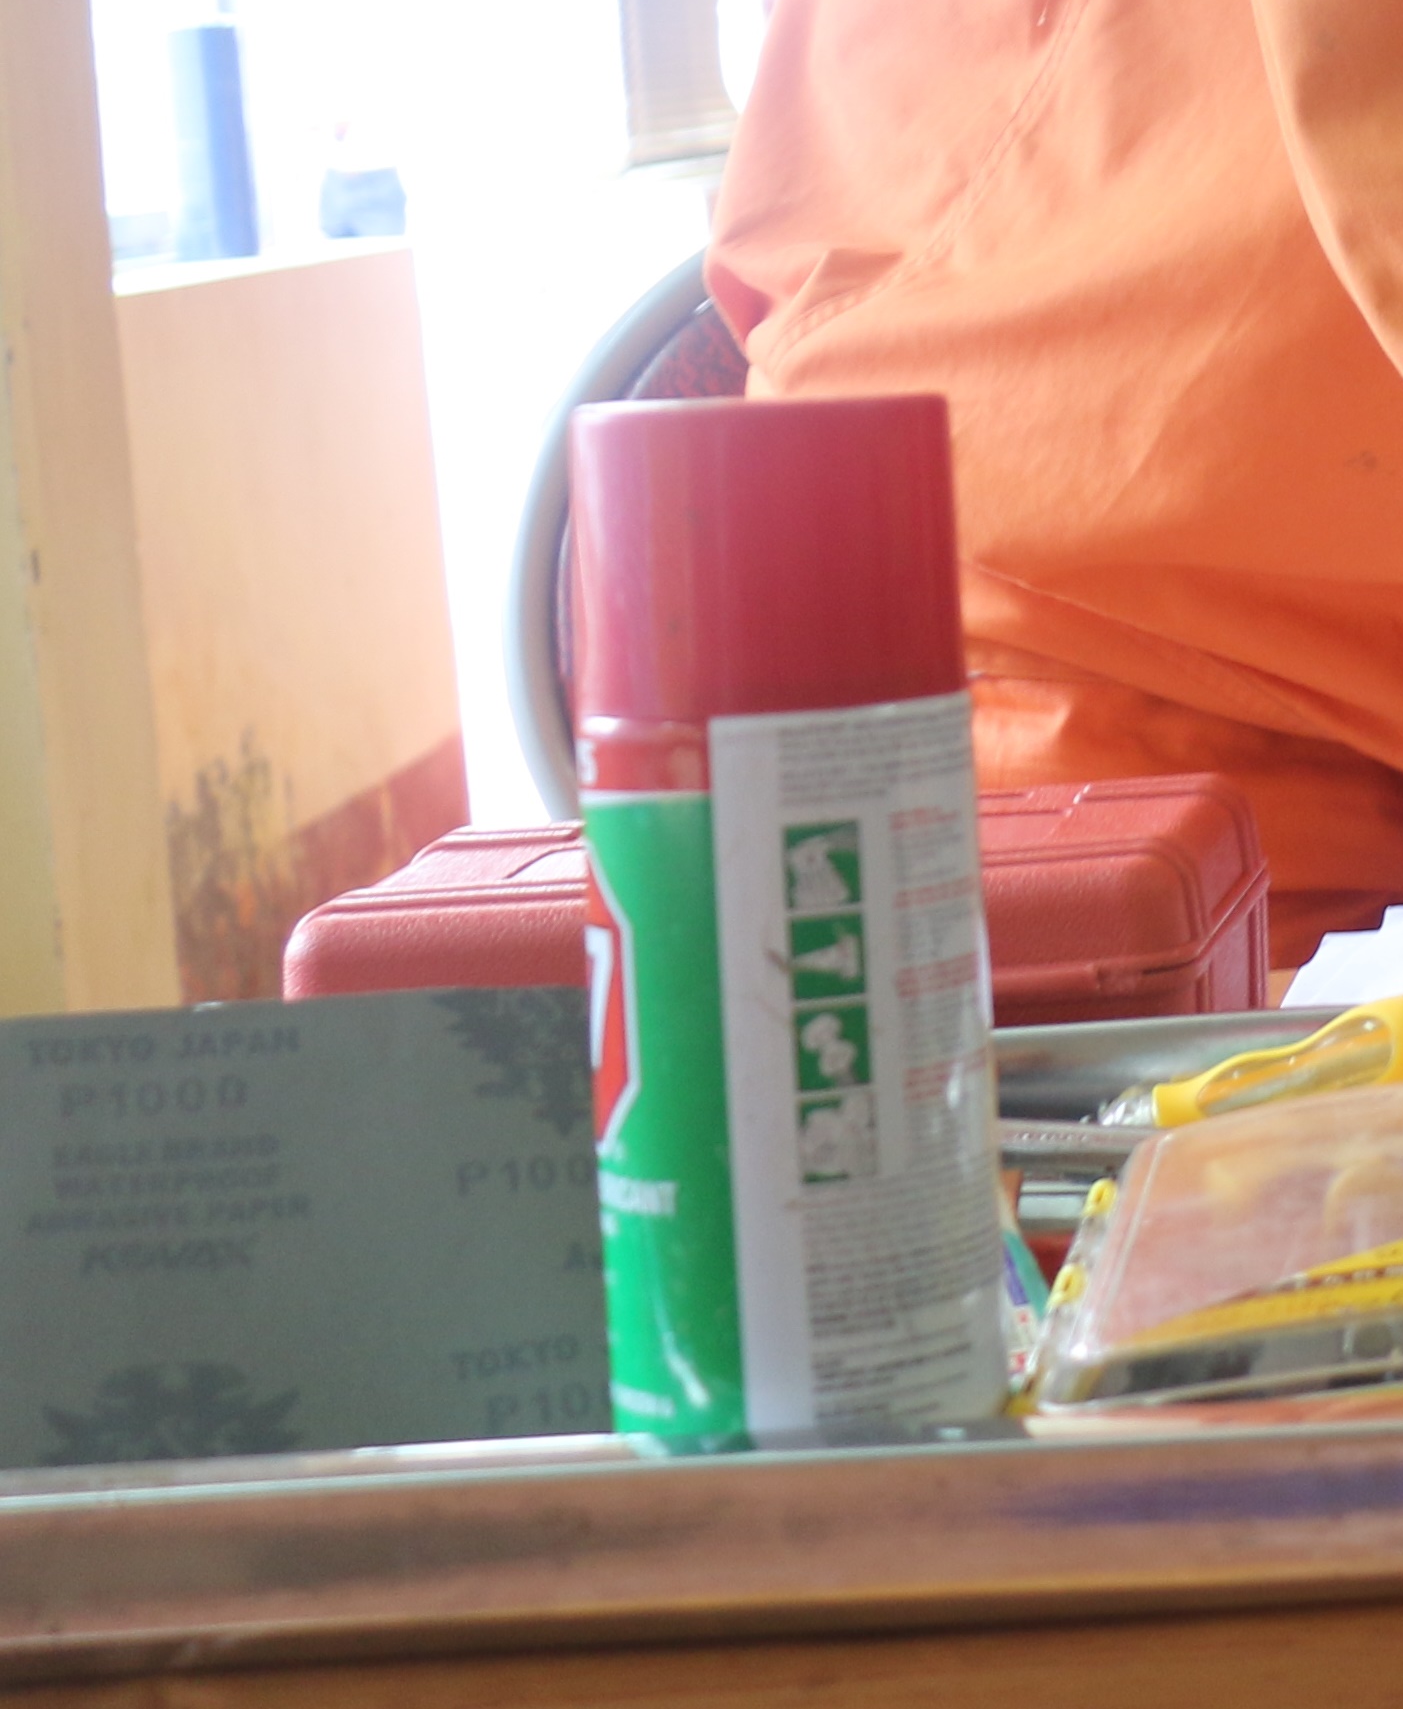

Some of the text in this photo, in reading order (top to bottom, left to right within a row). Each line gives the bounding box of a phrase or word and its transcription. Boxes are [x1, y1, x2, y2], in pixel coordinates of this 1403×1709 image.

[25, 1025, 302, 1066] TOKYO JAPAN
[58, 1073, 249, 1118] P1000
[161, 1132, 280, 1162] BRAND
[53, 1162, 281, 1200] WATERPROOF
[455, 1152, 597, 1197] P100
[23, 1193, 312, 1236] ABRASIVE PAPER
[451, 1333, 580, 1381] TOKYO
[484, 1380, 611, 1435] P10
